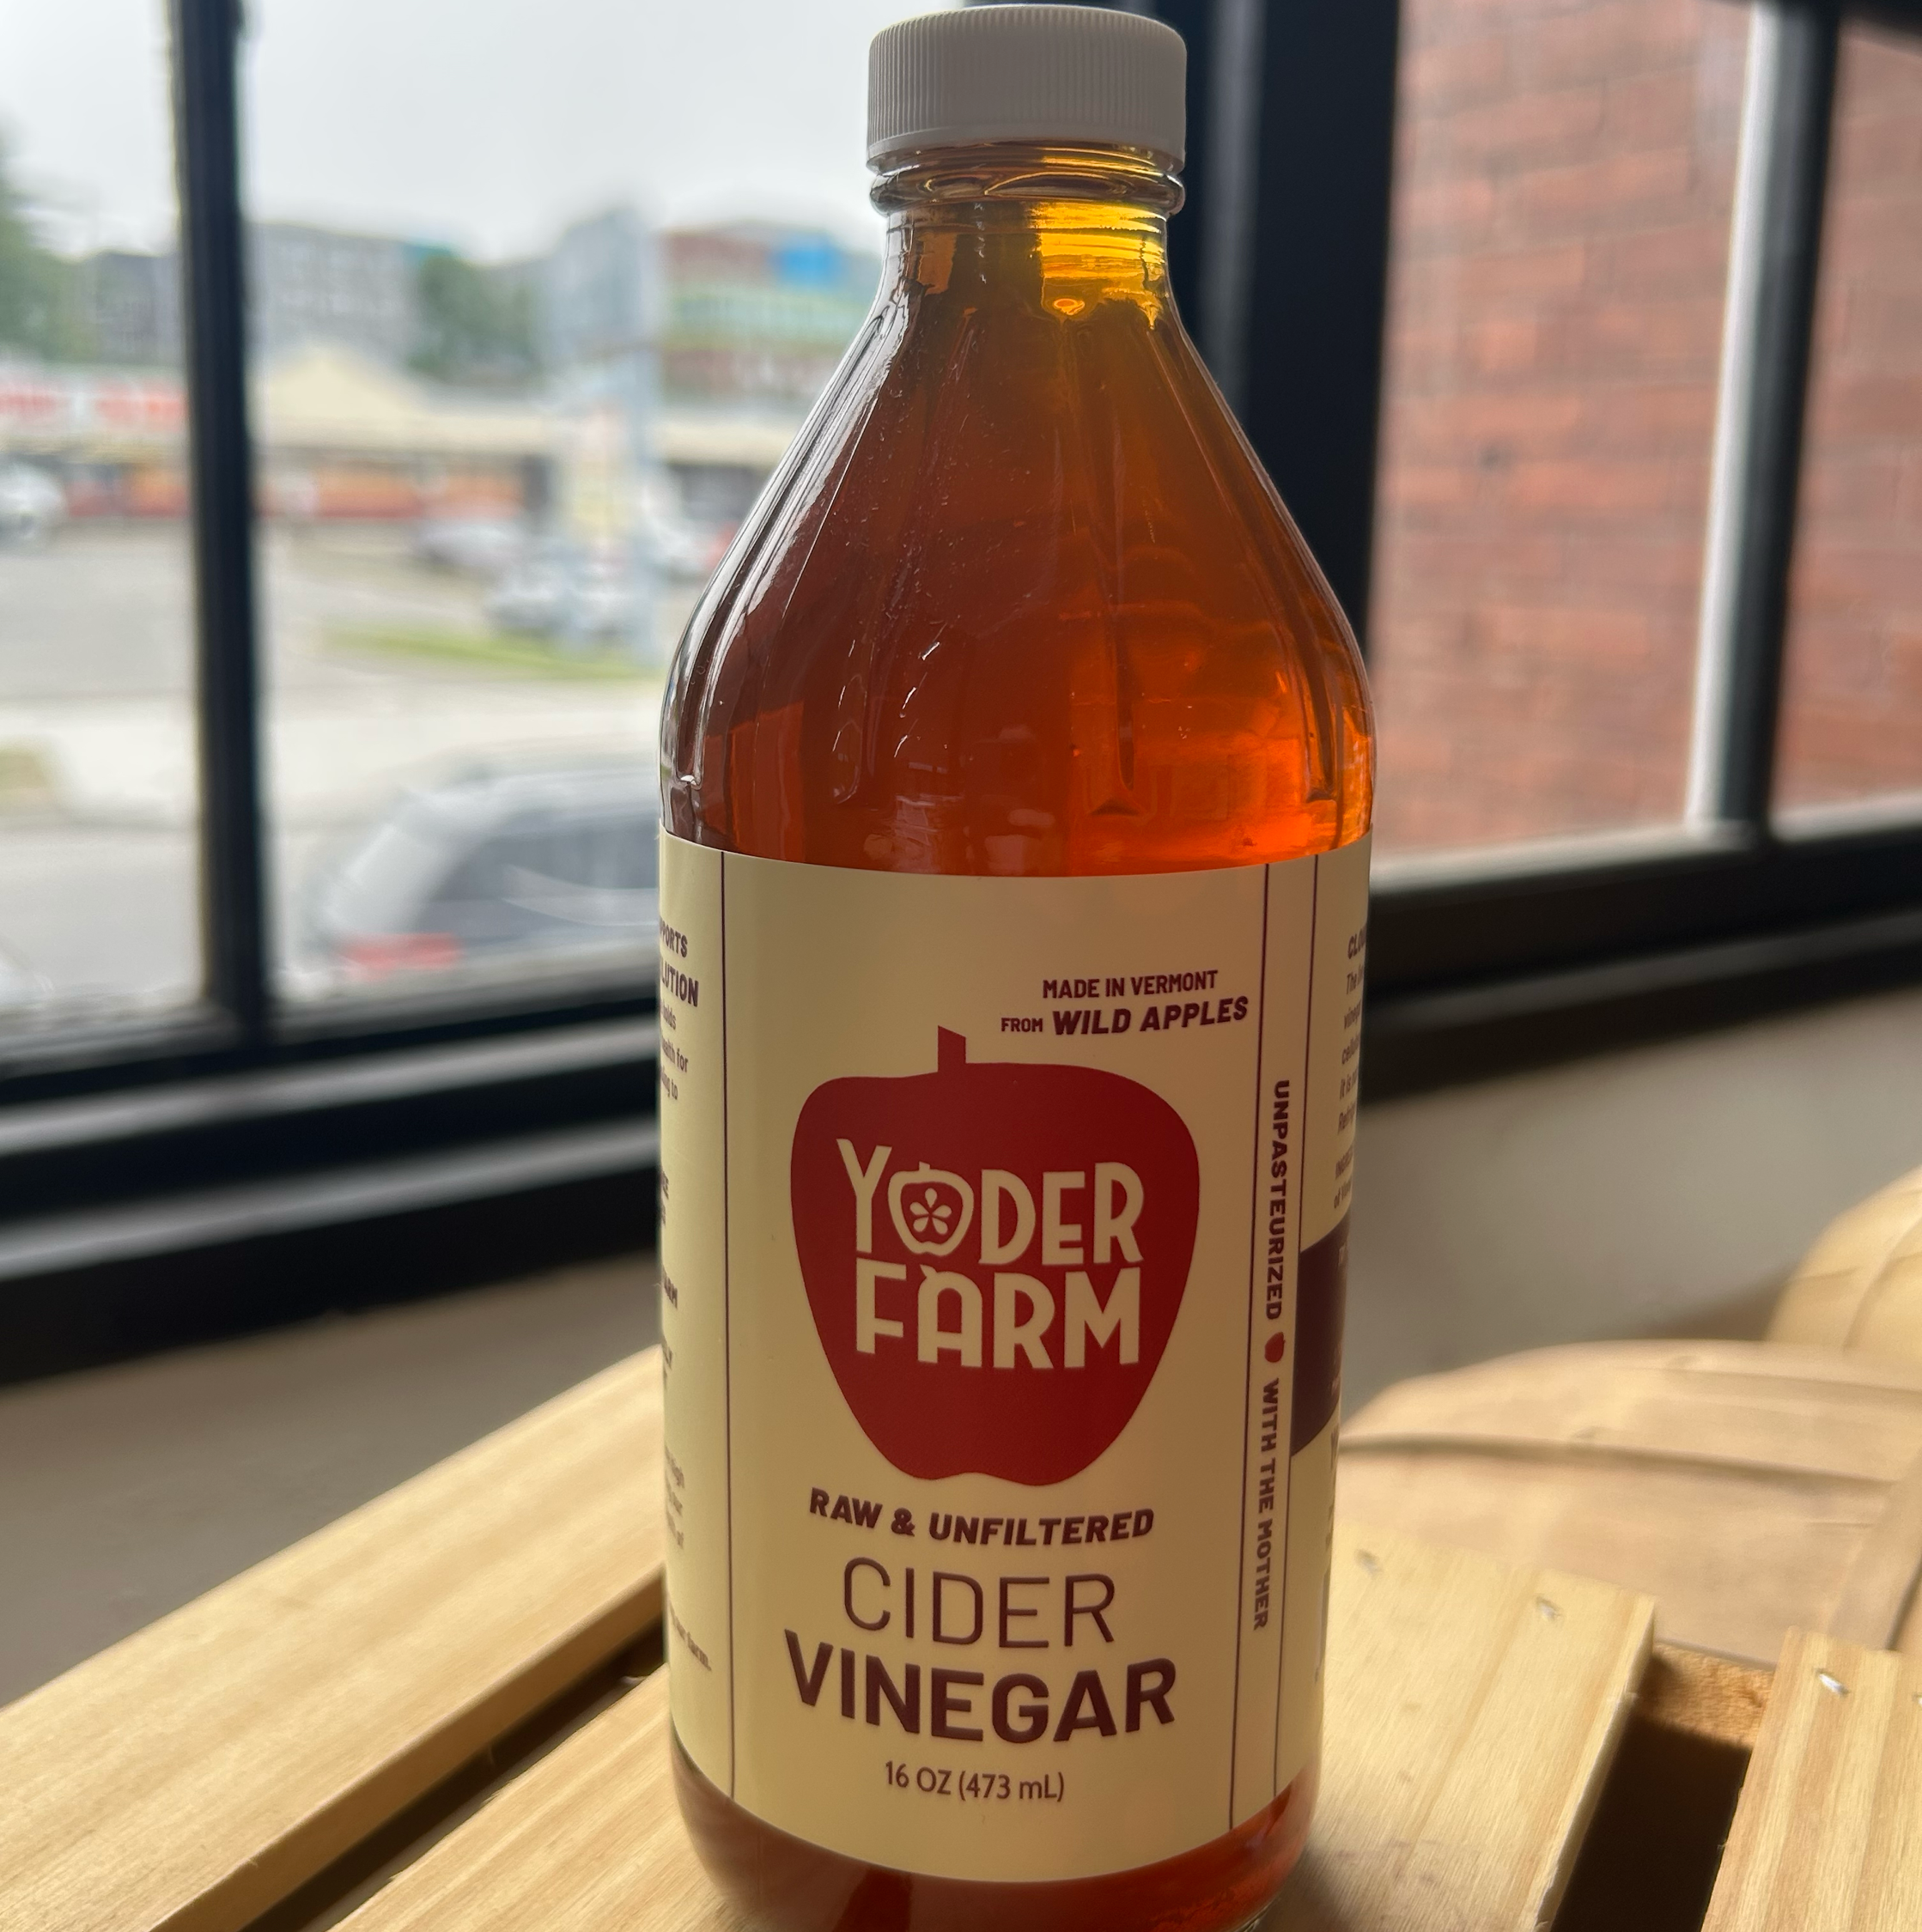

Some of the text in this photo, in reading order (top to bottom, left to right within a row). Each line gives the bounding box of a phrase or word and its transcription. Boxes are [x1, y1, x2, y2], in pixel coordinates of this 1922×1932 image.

[1001, 995, 1249, 1036] FROM WILD APPLES
[1042, 969, 1219, 999] MADE IN VERMONT
[676, 1048, 690, 1072] for
[836, 1138, 1145, 1266] YODER
[856, 1256, 1140, 1370] FARM
[1253, 1079, 1290, 1631] UNPASTEURIZED WITH THE MOTHER
[809, 1487, 1155, 1546] RAW & UNFILTERED
[843, 1556, 1116, 1648] CIDER
[784, 1627, 1176, 1744] VINEGAR
[885, 1759, 1065, 1802] 16 OZ (473 mL)
